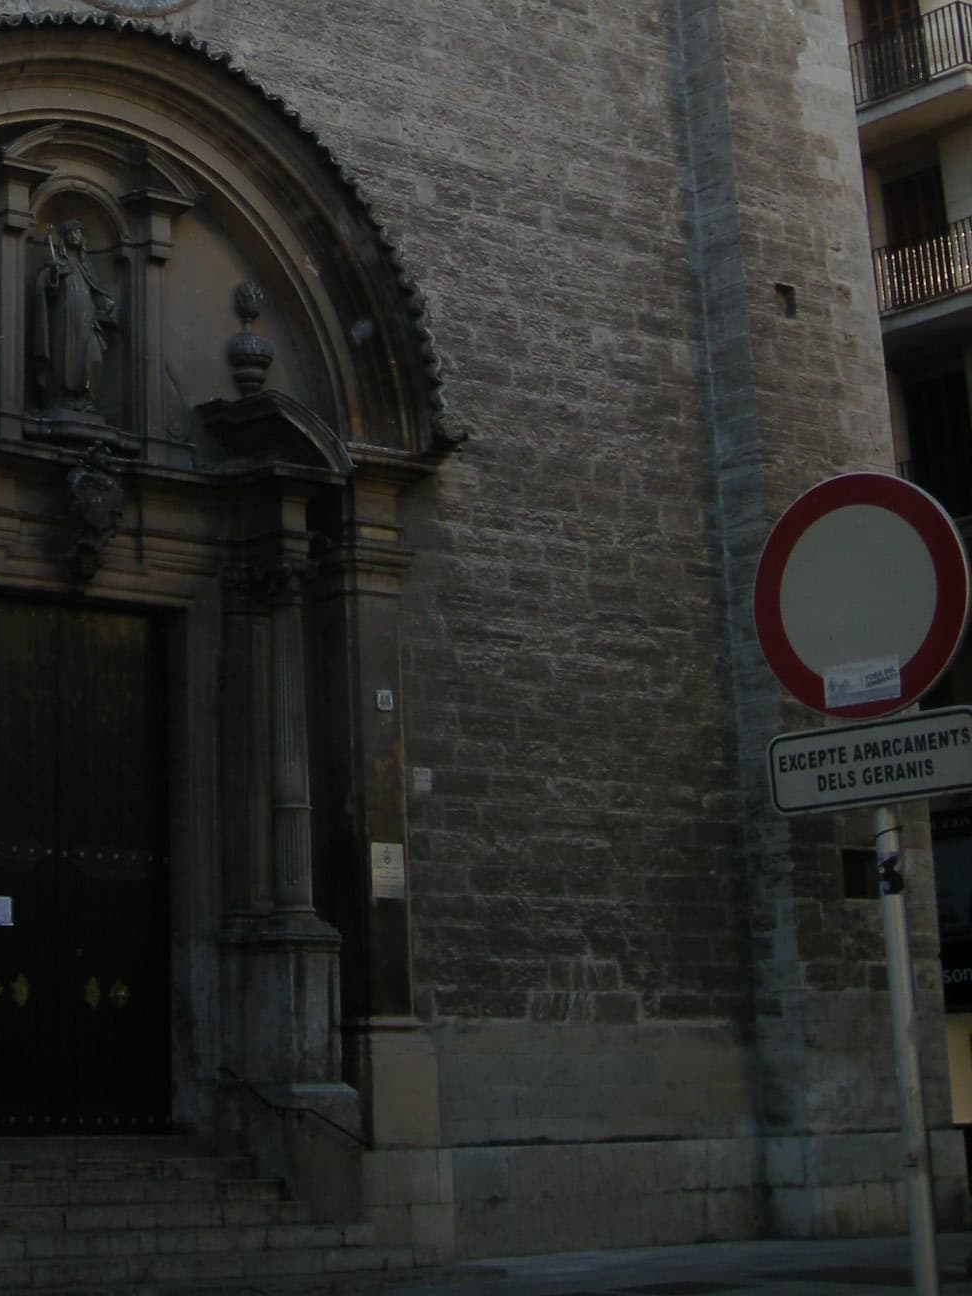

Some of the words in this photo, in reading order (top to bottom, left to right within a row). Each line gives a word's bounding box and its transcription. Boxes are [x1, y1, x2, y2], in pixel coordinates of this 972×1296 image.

[779, 746, 847, 773] EXCEPTE
[853, 727, 971, 761] APARCAMENTS
[817, 770, 856, 792] DELS
[862, 758, 935, 786] GERANIS
